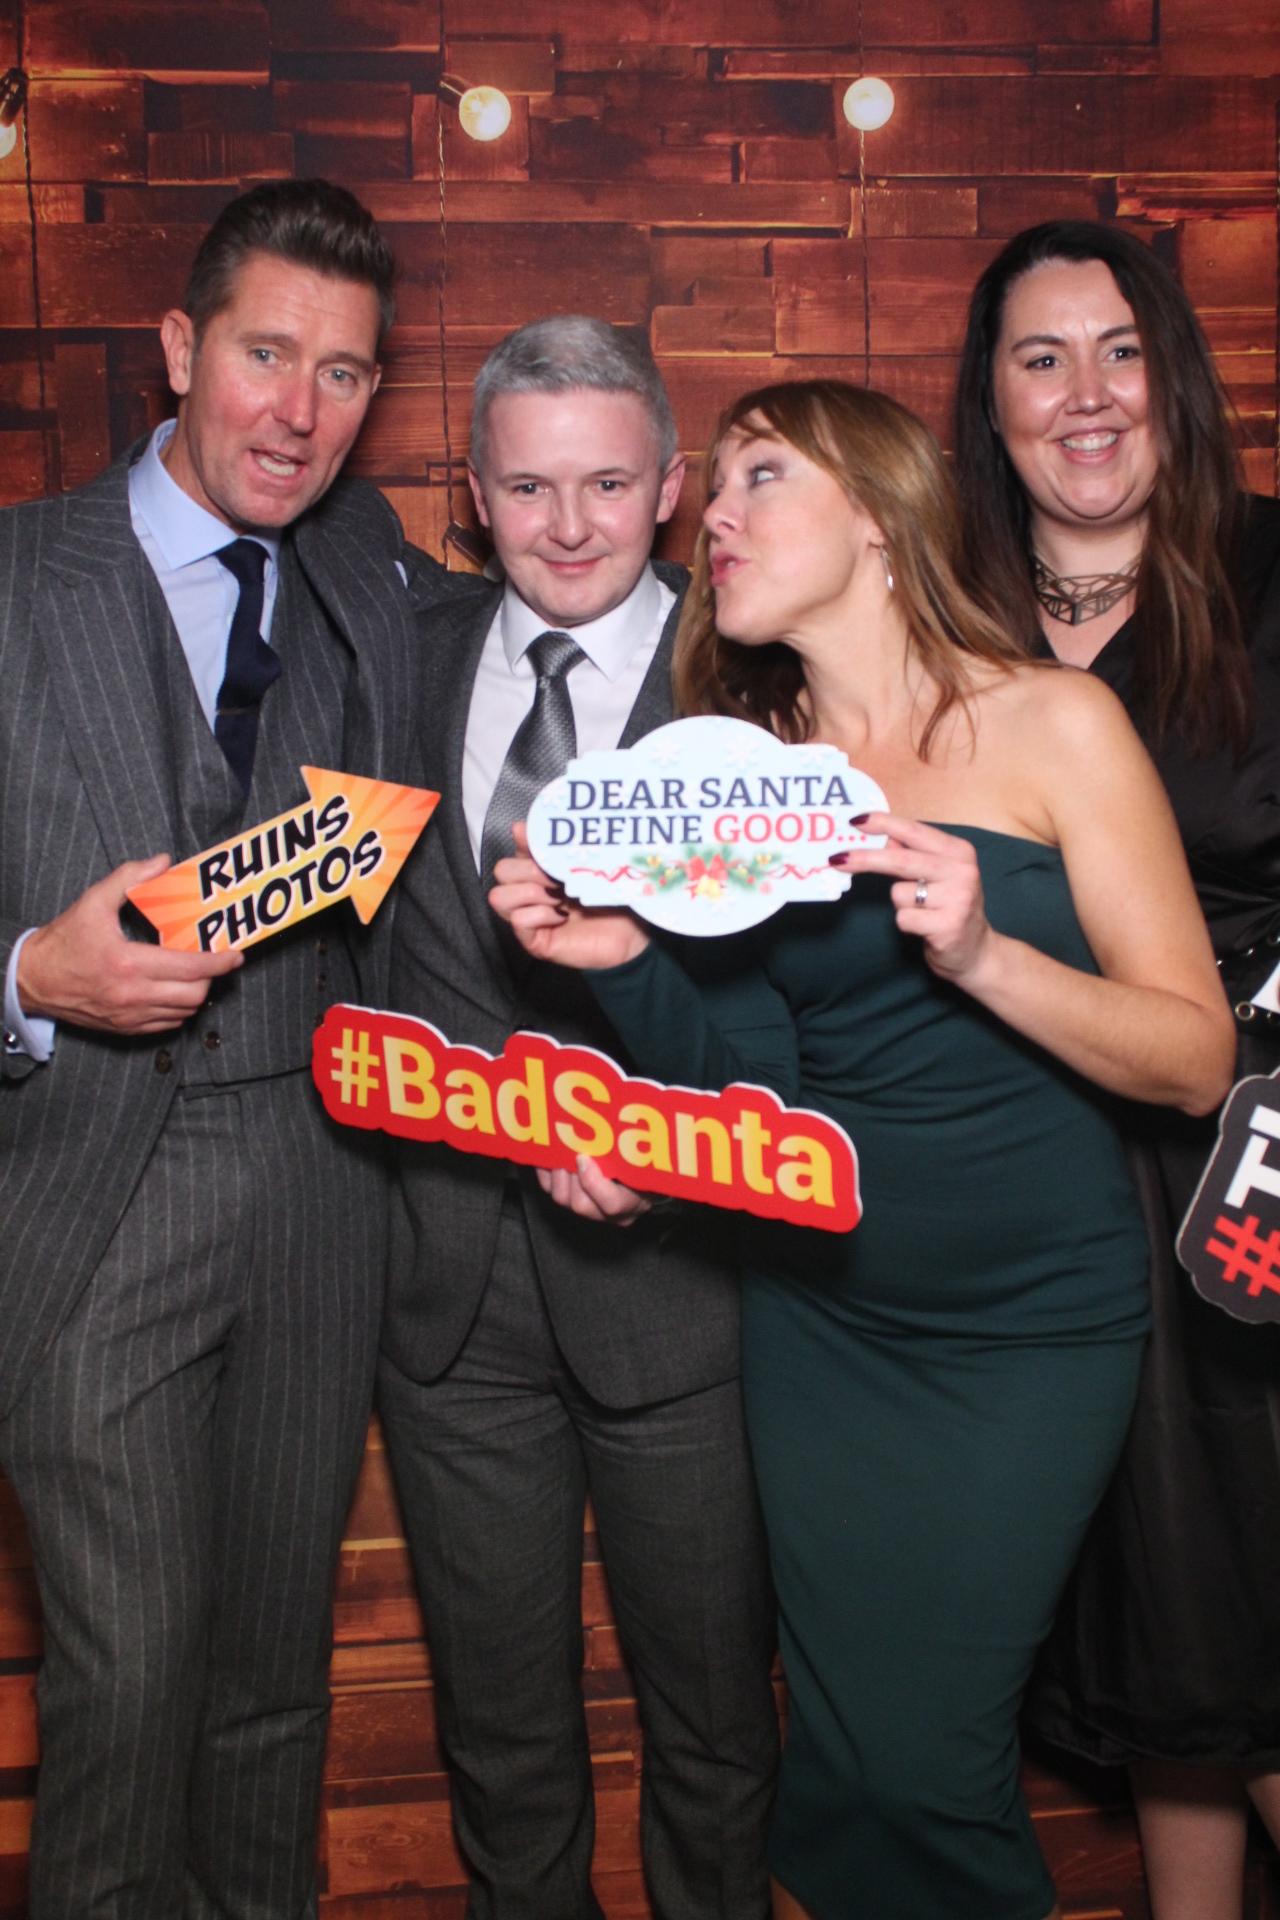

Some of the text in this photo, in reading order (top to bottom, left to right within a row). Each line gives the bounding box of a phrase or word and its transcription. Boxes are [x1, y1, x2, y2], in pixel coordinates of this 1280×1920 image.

[548, 812, 867, 846] DEFINE GOOD...
[567, 775, 853, 811] DEAR SANTA
[198, 830, 383, 952] PHOTOS
[199, 795, 350, 901] RUINS
[331, 1027, 836, 1208] #BadSanta
